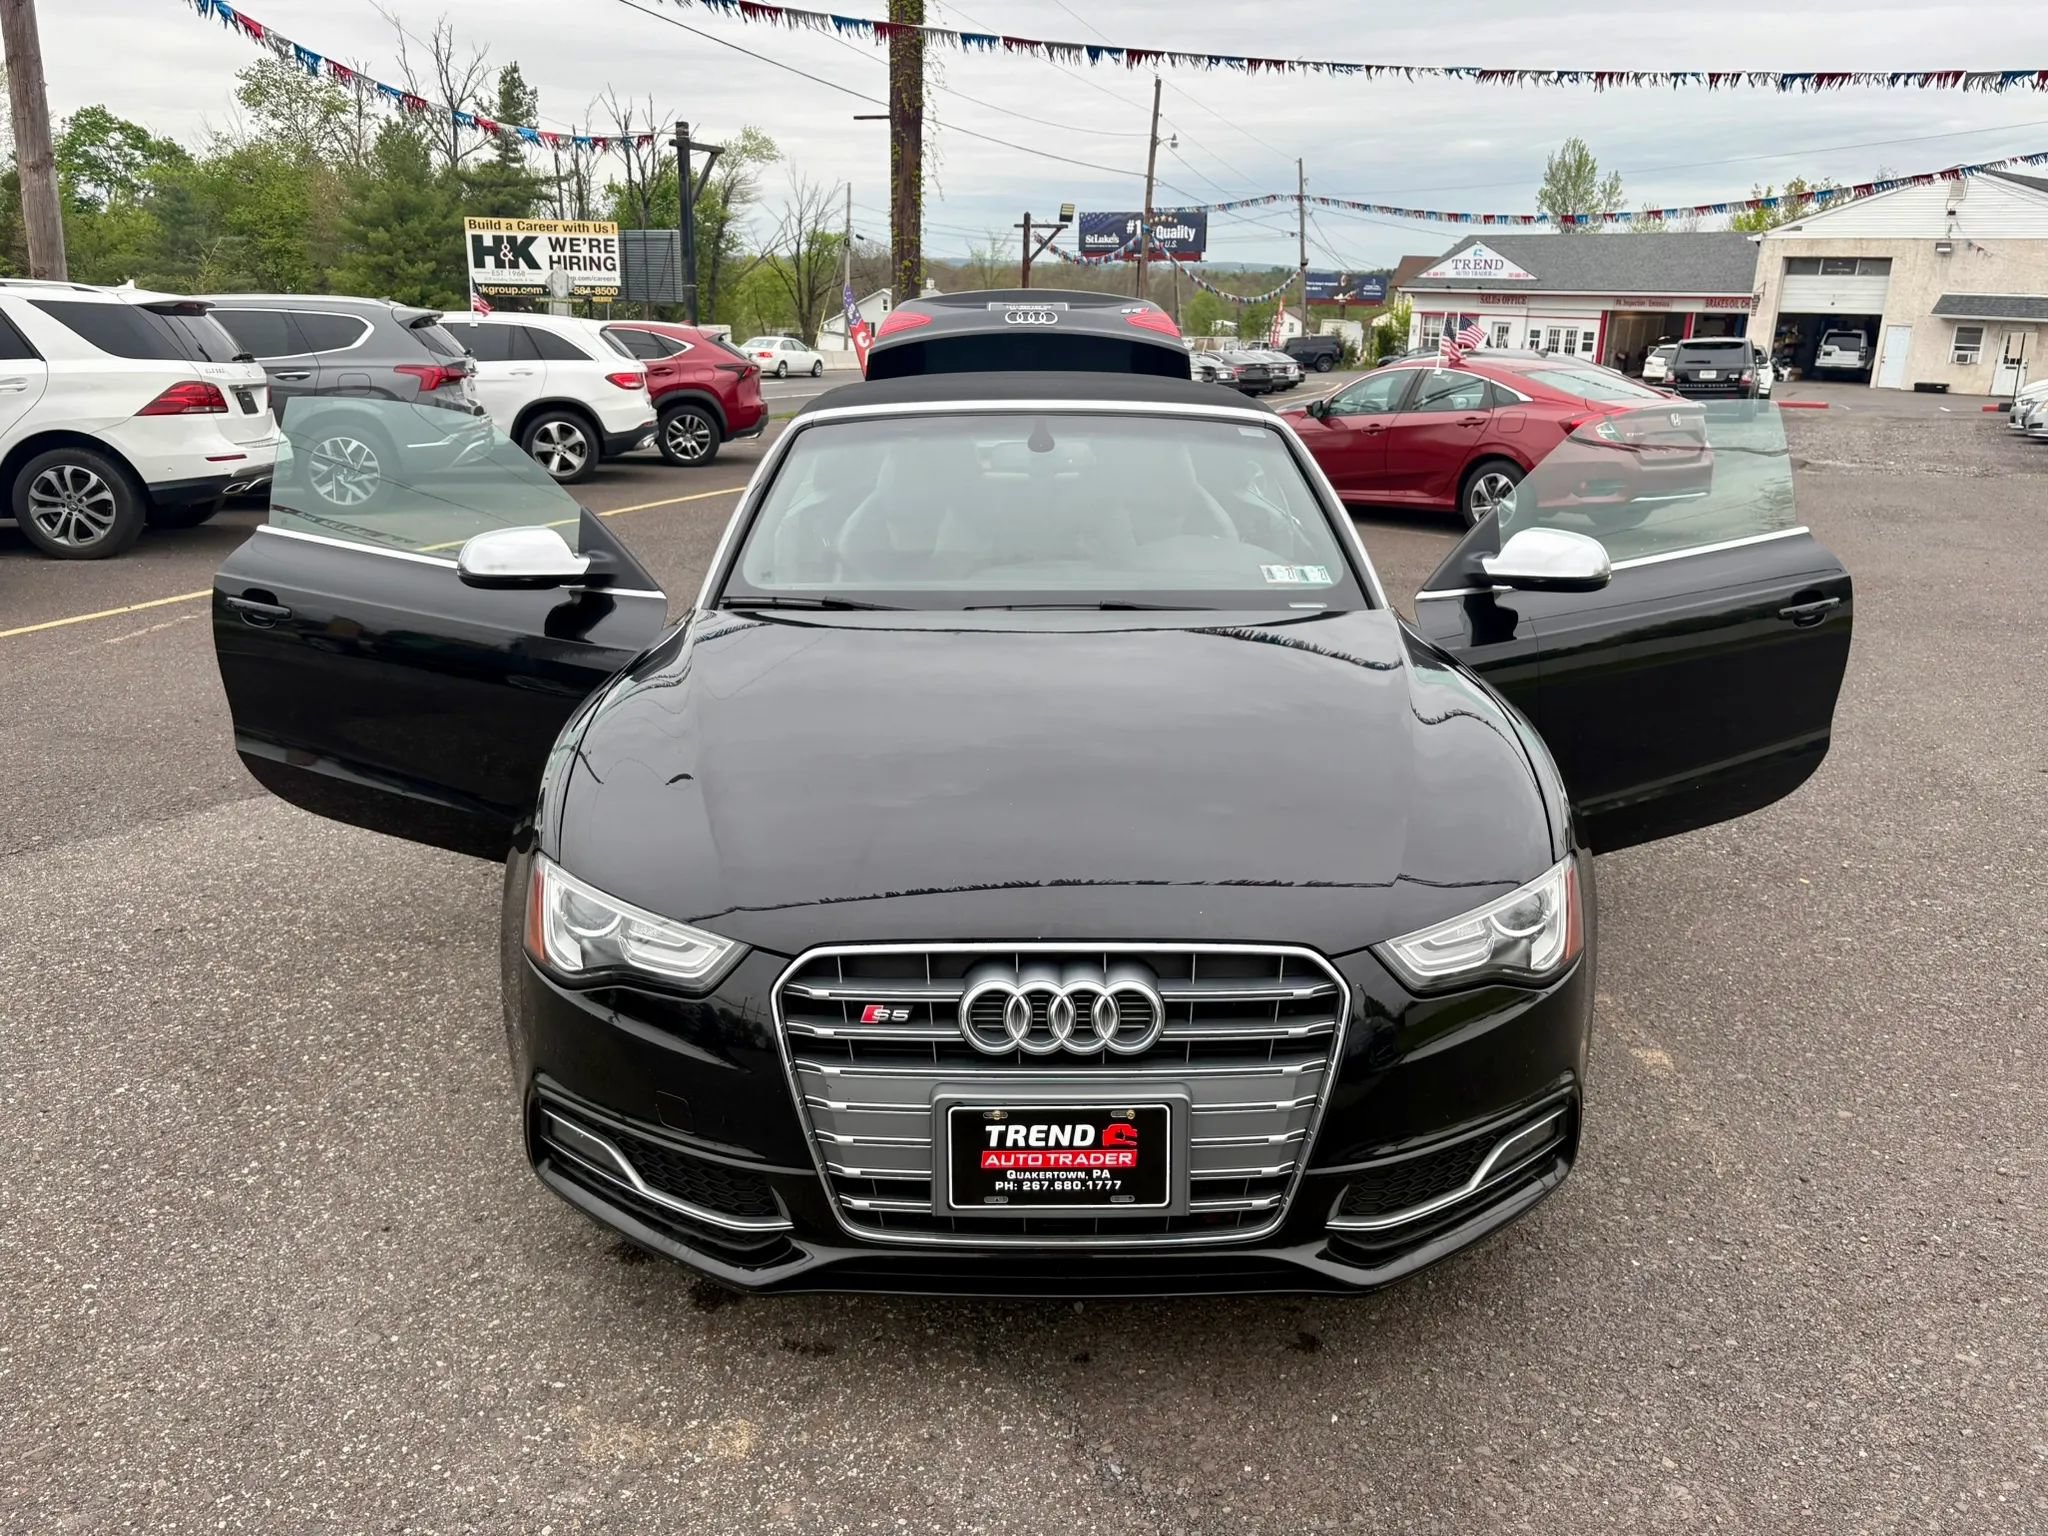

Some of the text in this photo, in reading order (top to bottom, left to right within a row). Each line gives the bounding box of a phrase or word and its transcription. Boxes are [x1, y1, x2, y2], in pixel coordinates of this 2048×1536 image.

[468, 219, 501, 230] Build
[505, 222, 513, 231] a
[517, 220, 558, 232] Career
[562, 223, 589, 233] with
[593, 223, 609, 233] Us
[1126, 219, 1196, 241] #1 Quality
[548, 236, 616, 254] WE'RE
[1164, 240, 1178, 248] U.S.
[471, 234, 543, 269] H&K
[549, 255, 617, 272] HIRING
[1451, 259, 1504, 270] TREND
[1502, 295, 1527, 305] OFFICE
[985, 1124, 1095, 1147] TREND
[985, 1152, 1132, 1166] AUTO TRADER
[1093, 1169, 1111, 1179] PA
[995, 1180, 1122, 1190] PH: 267.680.1777
